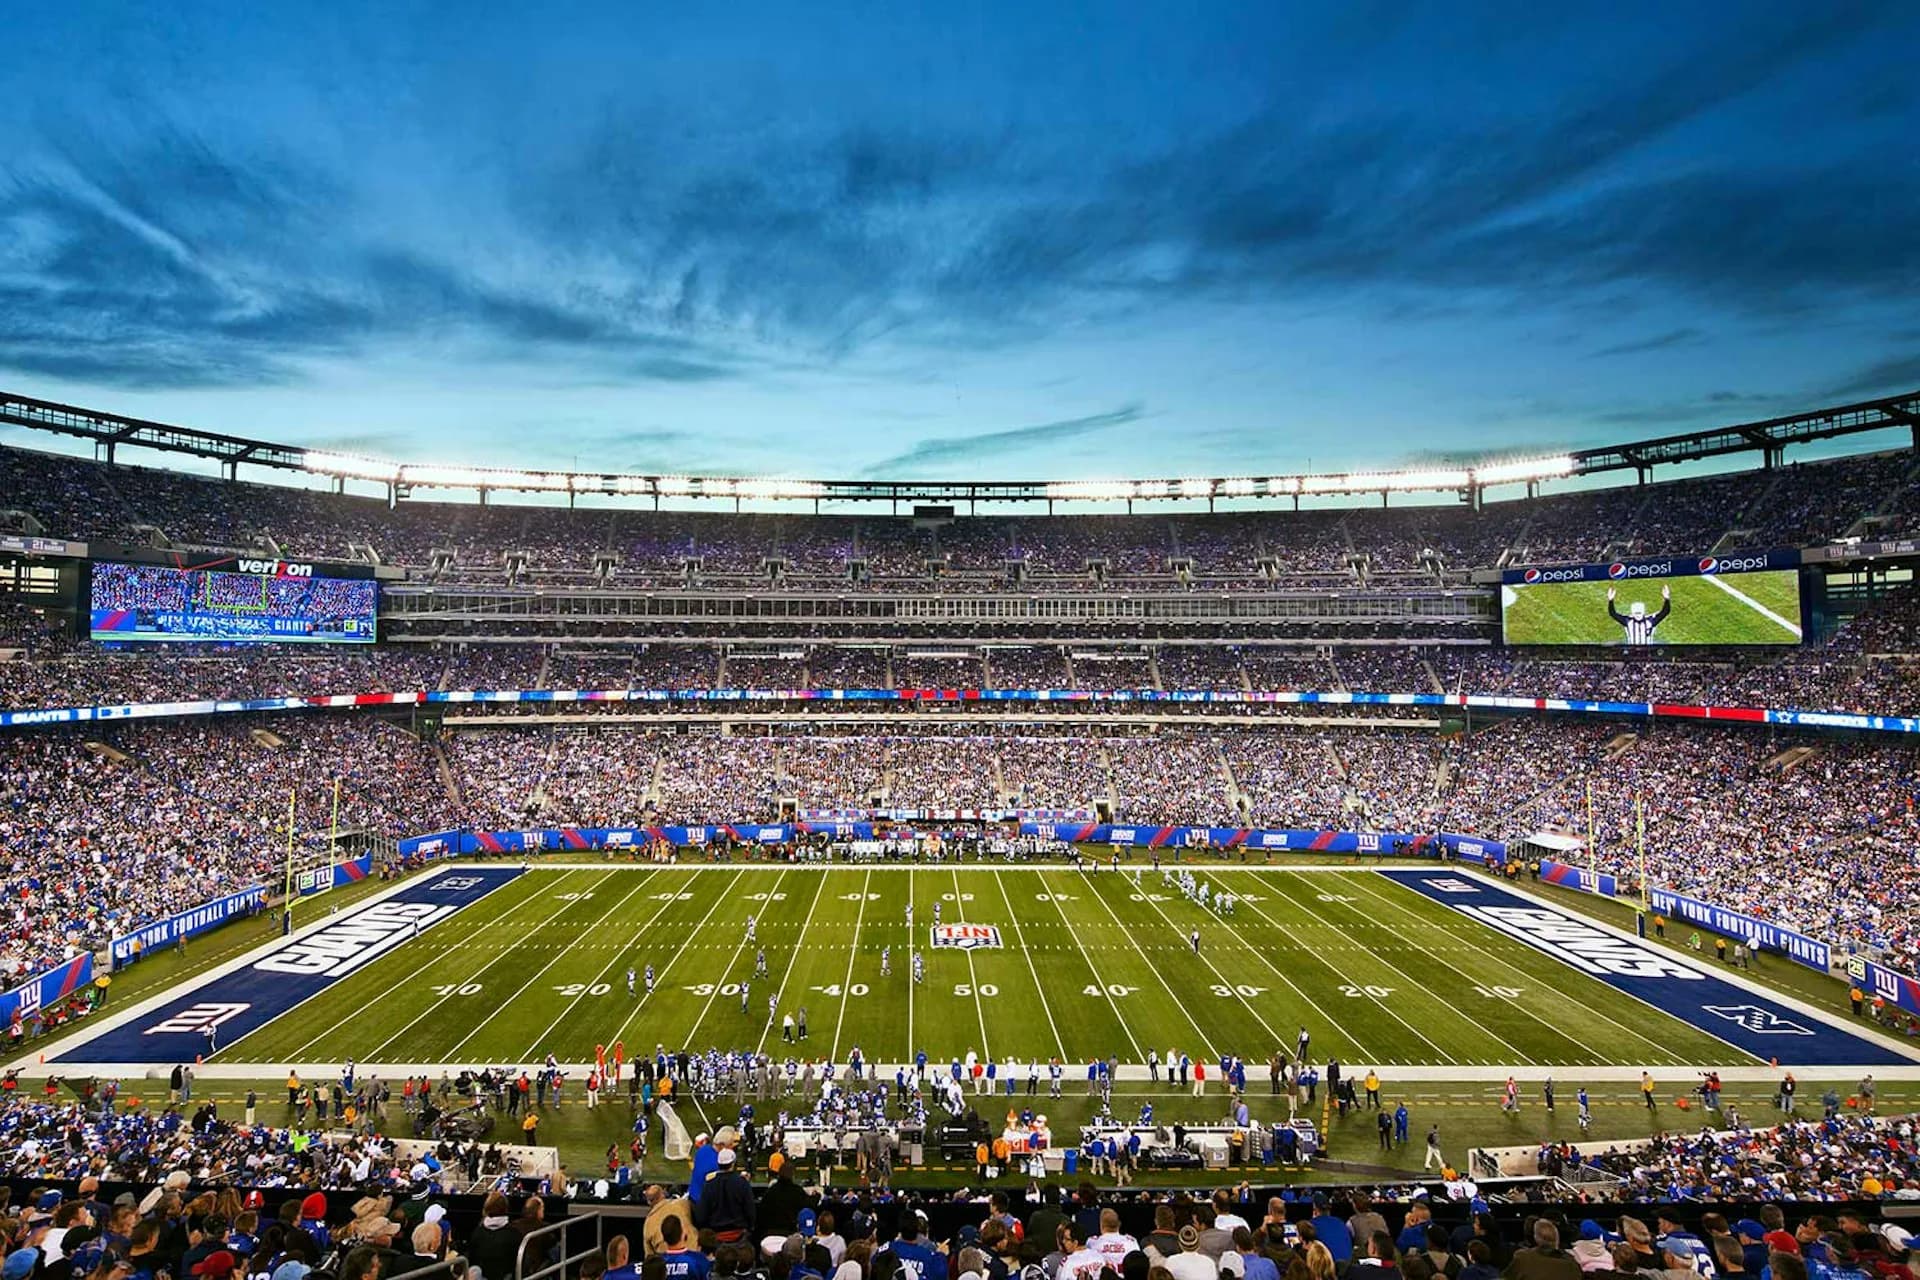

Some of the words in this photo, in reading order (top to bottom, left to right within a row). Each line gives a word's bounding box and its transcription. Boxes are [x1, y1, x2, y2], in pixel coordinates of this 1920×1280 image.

[32, 539, 44, 550] 21
[238, 558, 313, 579] verizon
[1627, 561, 1672, 578] pepsi
[1719, 554, 1768, 573] pepsi
[1543, 567, 1584, 582] pepsi
[141, 923, 168, 948] YORK
[173, 903, 224, 936] FOOTBALL
[1681, 900, 1712, 924] YORK
[1716, 911, 1776, 946] FOOTBALL
[1780, 933, 1825, 965] GIANTS
[253, 901, 438, 974] GIANTS
[1477, 905, 1706, 979] GIANTS
[1850, 960, 1863, 976] 25
[435, 984, 483, 996] 10
[559, 984, 611, 996] 20
[693, 984, 740, 996] 30
[822, 984, 869, 996] 40
[953, 984, 999, 996] 50
[1082, 984, 1129, 996] 40
[1209, 984, 1259, 996] 30
[1337, 985, 1390, 997] 20
[1472, 985, 1520, 997] 10
[1874, 967, 1898, 1002] ny
[19, 980, 42, 1018] ny
[143, 1003, 251, 1034] ny
